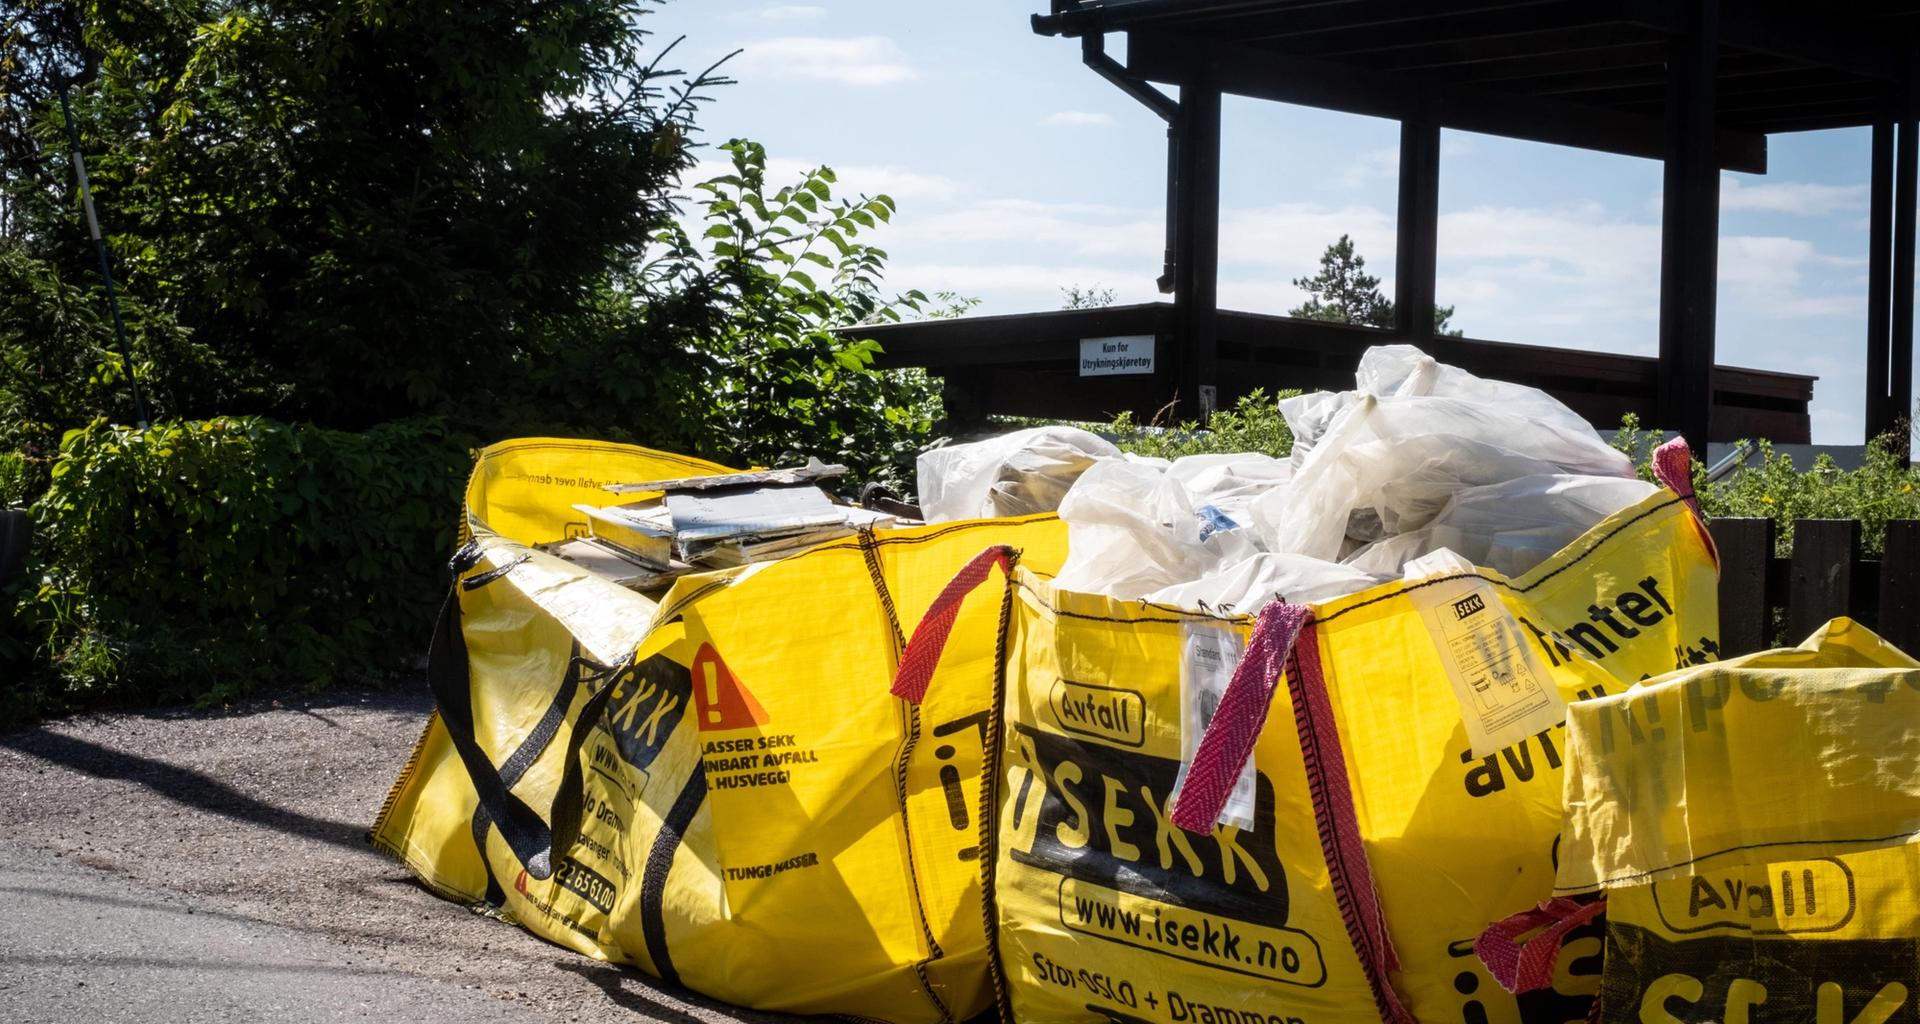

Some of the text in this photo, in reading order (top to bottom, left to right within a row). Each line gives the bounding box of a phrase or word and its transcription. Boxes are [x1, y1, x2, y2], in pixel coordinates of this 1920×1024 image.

[1102, 342, 1128, 353] Kun for
[1062, 692, 1129, 733] Avfall
[758, 735, 796, 751] SEKK
[763, 750, 818, 768] AVFALL
[556, 861, 615, 909] 22 65 61 00
[727, 864, 772, 881] TUNGE
[1689, 873, 1817, 918] Avall
[1075, 896, 1300, 974] www.isekk.no
